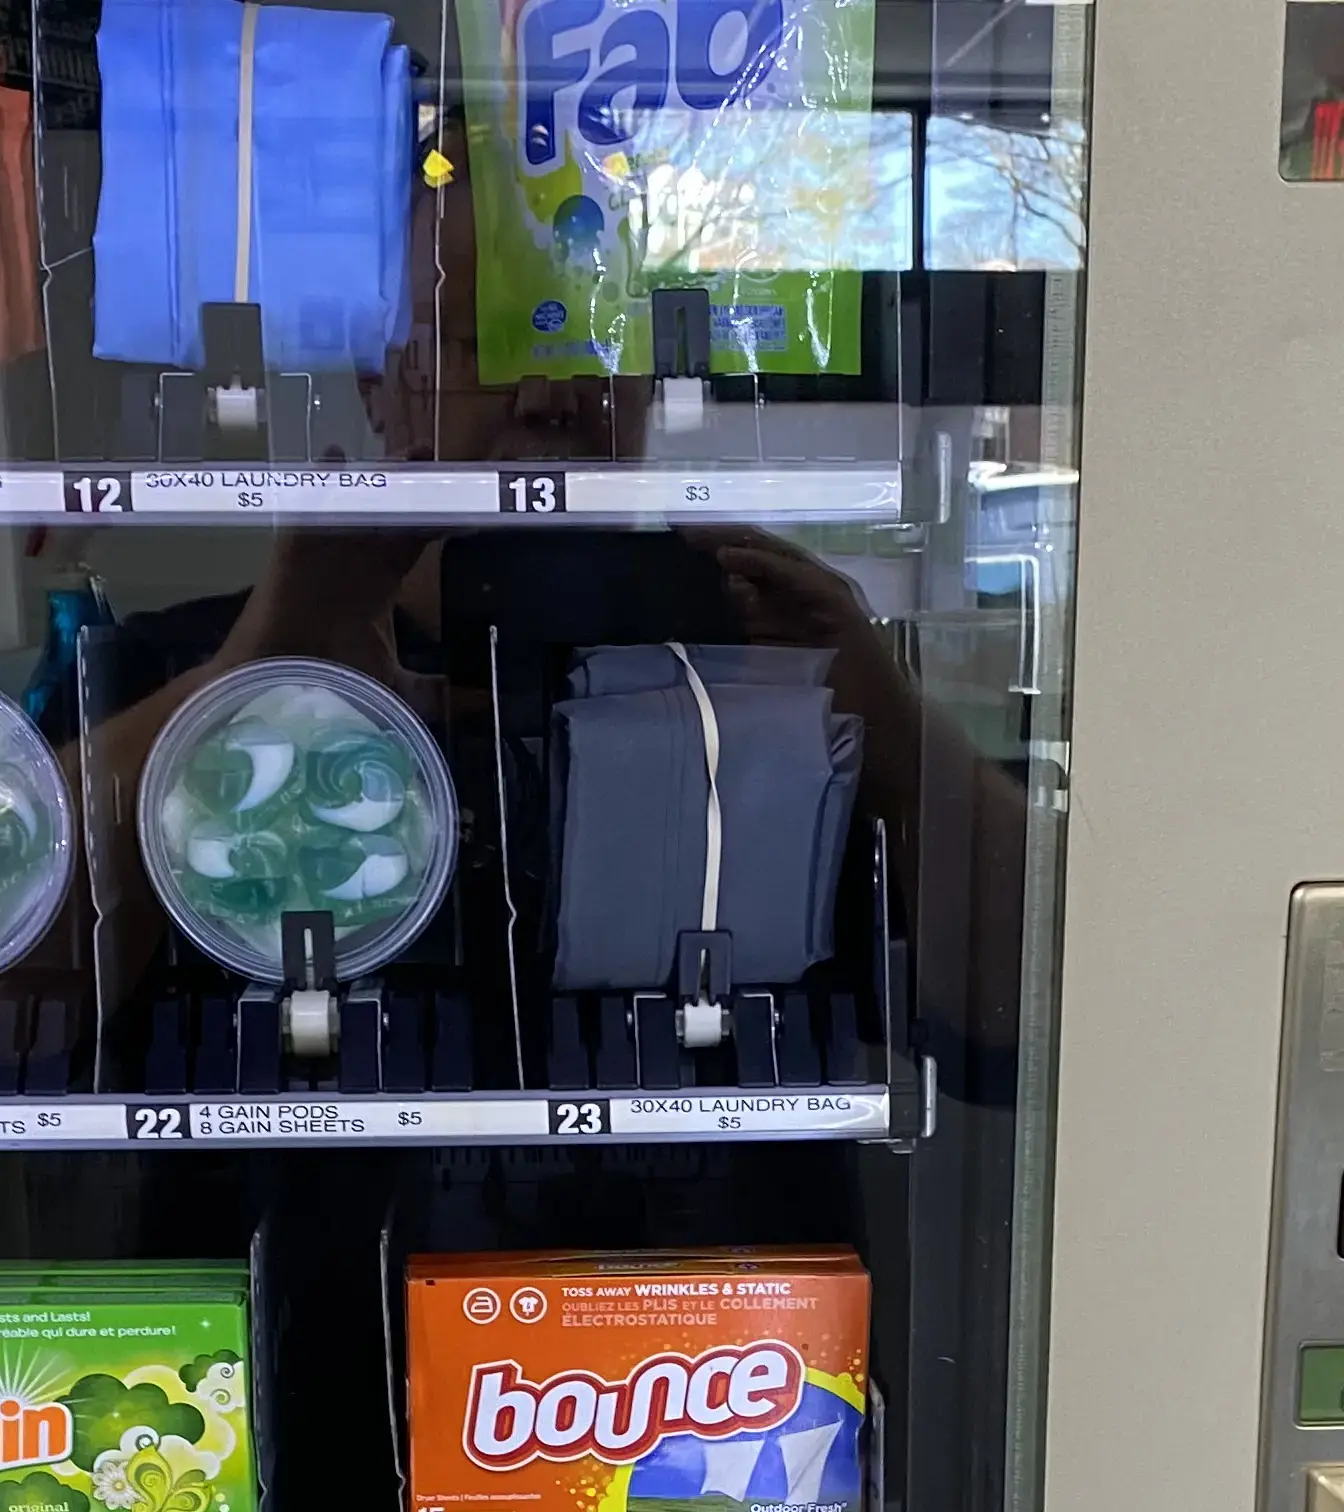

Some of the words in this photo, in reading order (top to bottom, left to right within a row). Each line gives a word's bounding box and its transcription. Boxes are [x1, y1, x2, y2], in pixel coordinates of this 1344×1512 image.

[74, 477, 122, 512] 12
[146, 473, 213, 487] 30X40
[222, 474, 329, 488] LAUNDRY
[340, 474, 387, 488] BAG
[508, 476, 555, 513] 13
[685, 485, 710, 503] $3
[237, 492, 263, 508] $5
[199, 1106, 210, 1118] 4
[218, 1105, 269, 1118] GAIN
[278, 1105, 338, 1118] PODS
[557, 1104, 602, 1134] 23
[631, 1100, 692, 1113] 30X40
[700, 1098, 799, 1112] LAUNDRY
[807, 1097, 851, 1110] BAG
[37, 1113, 61, 1127] $5
[135, 1108, 182, 1138] 22
[398, 1112, 422, 1126] $5
[717, 1116, 741, 1129] $5
[201, 1121, 212, 1134] 8
[219, 1120, 271, 1133] GAIN
[279, 1119, 365, 1132] SHEETS
[562, 1288, 593, 1297] TOSS
[596, 1287, 631, 1296] AWAY
[635, 1283, 718, 1296] WRINKLES
[722, 1283, 732, 1295] &
[737, 1283, 791, 1295] STATIC
[562, 1303, 614, 1312] OUBLIEZ
[617, 1302, 640, 1311] LES
[643, 1299, 677, 1311] PLIS
[682, 1301, 697, 1310] ET
[700, 1301, 715, 1310] LE
[720, 1298, 817, 1310] COLLEMENT
[23, 1312, 48, 1323] and
[51, 1311, 91, 1322] Lasts!
[42, 1327, 63, 1340] qui
[66, 1326, 97, 1338] dure
[100, 1326, 114, 1337] et
[117, 1325, 176, 1340] perdure!
[467, 1344, 795, 1463] bounce
[751, 1503, 804, 1512] Outdoor
